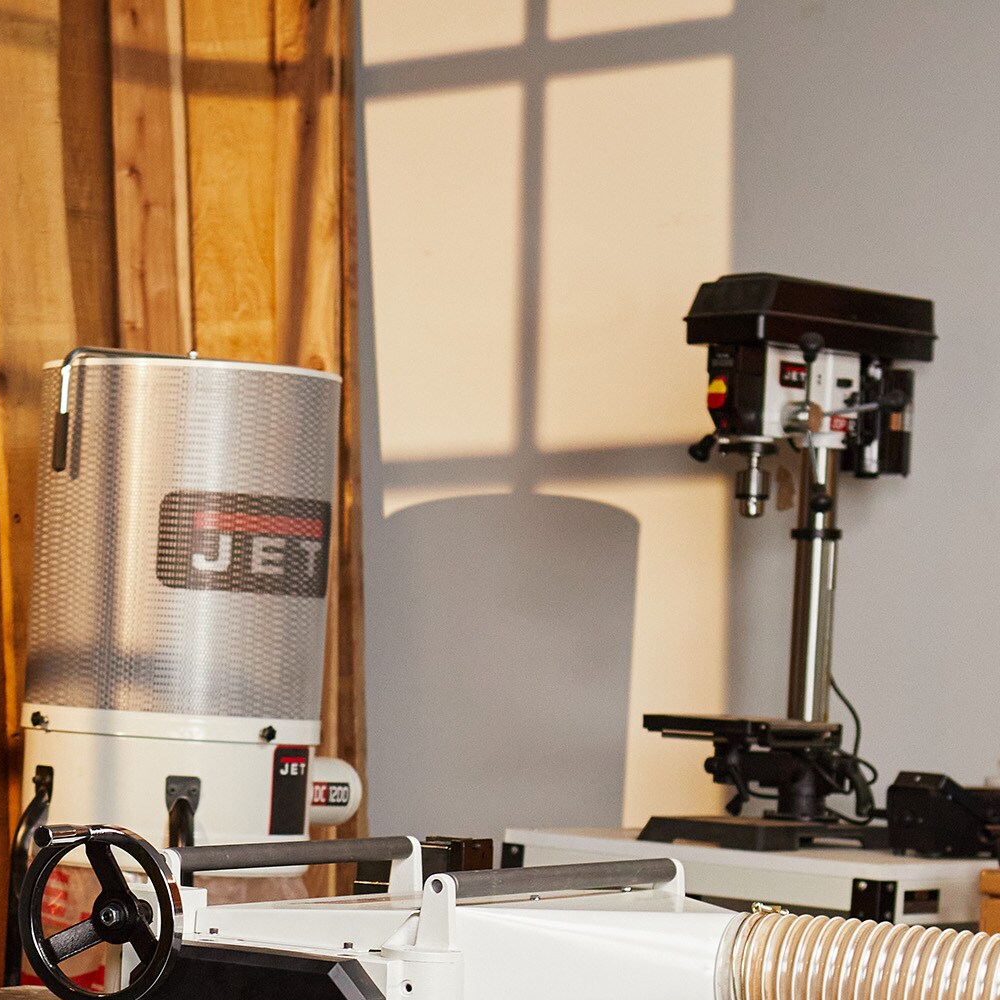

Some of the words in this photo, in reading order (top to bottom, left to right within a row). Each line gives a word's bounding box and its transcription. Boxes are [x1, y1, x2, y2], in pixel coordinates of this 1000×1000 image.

[192, 533, 322, 578] JET
[279, 763, 306, 776] JET
[313, 785, 327, 803] DC
